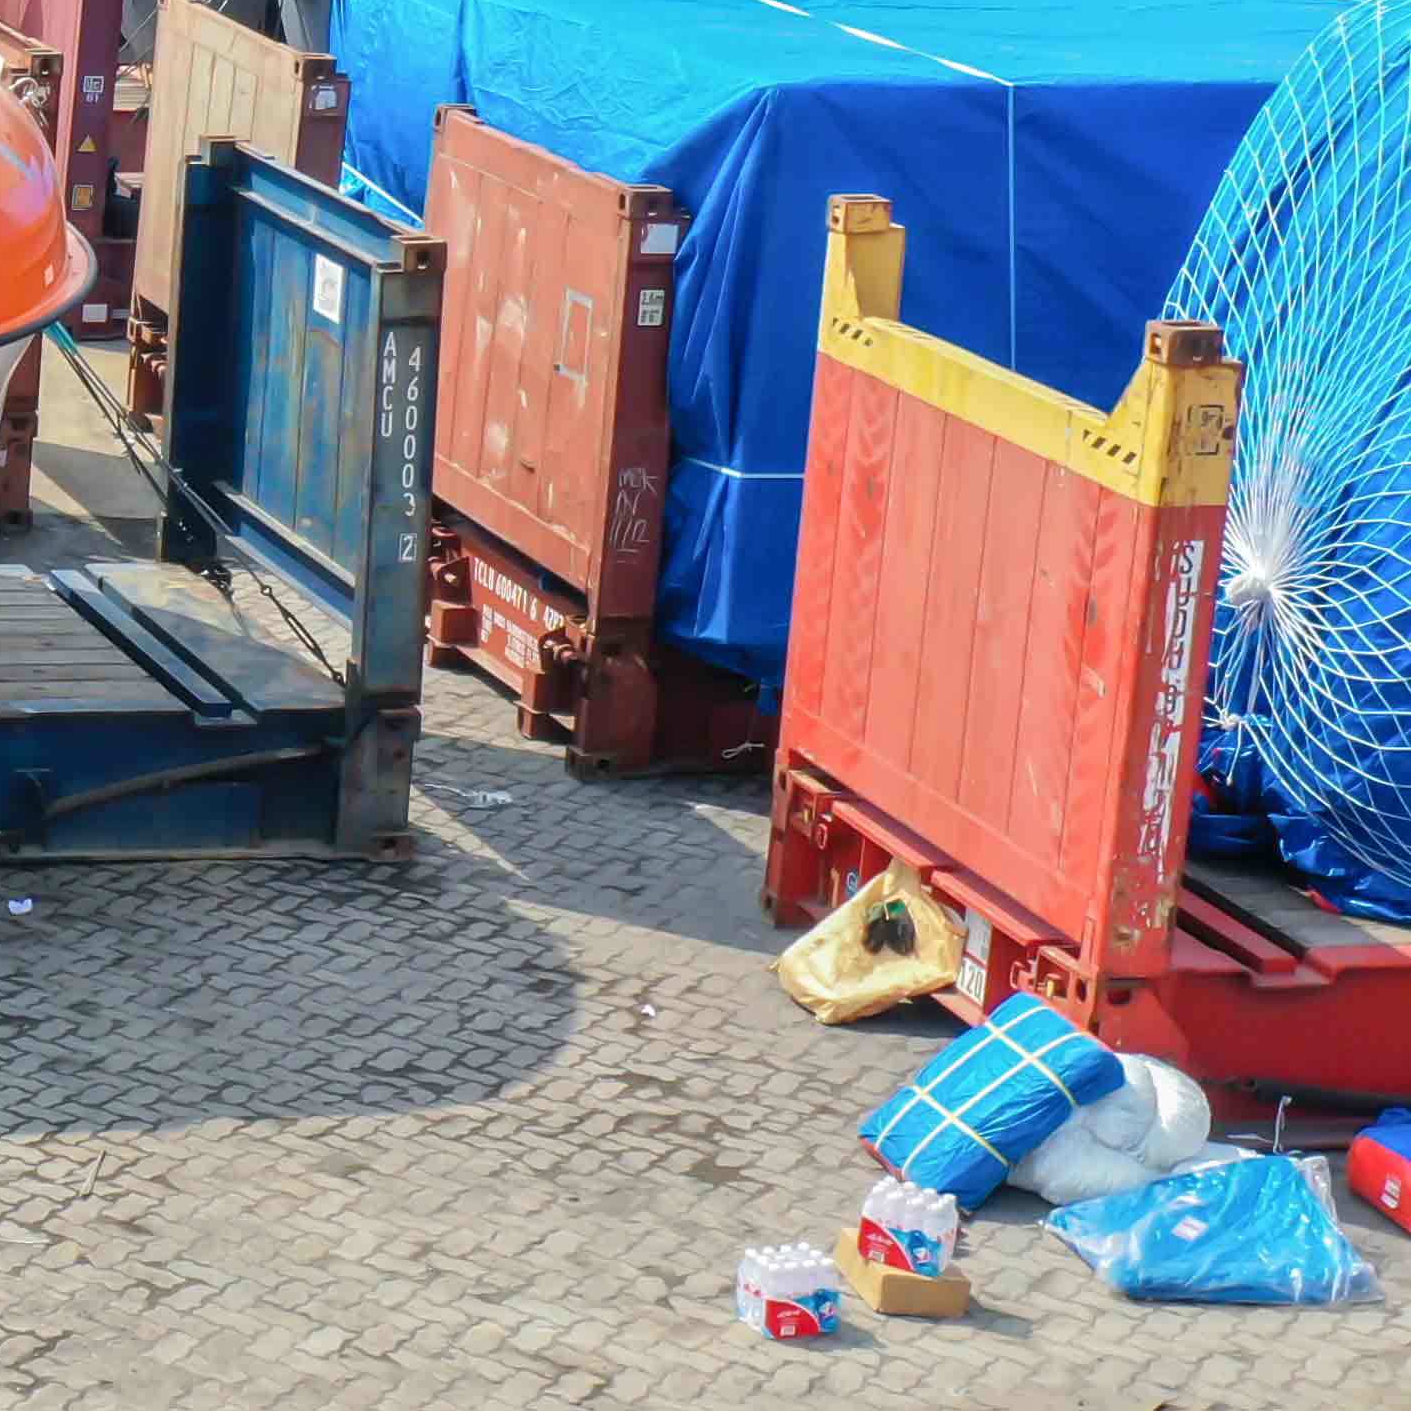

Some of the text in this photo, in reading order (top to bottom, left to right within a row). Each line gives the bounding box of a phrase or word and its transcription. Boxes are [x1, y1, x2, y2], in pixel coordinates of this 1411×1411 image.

[381, 331, 398, 438] AMCU
[402, 346, 423, 562] 460003 2
